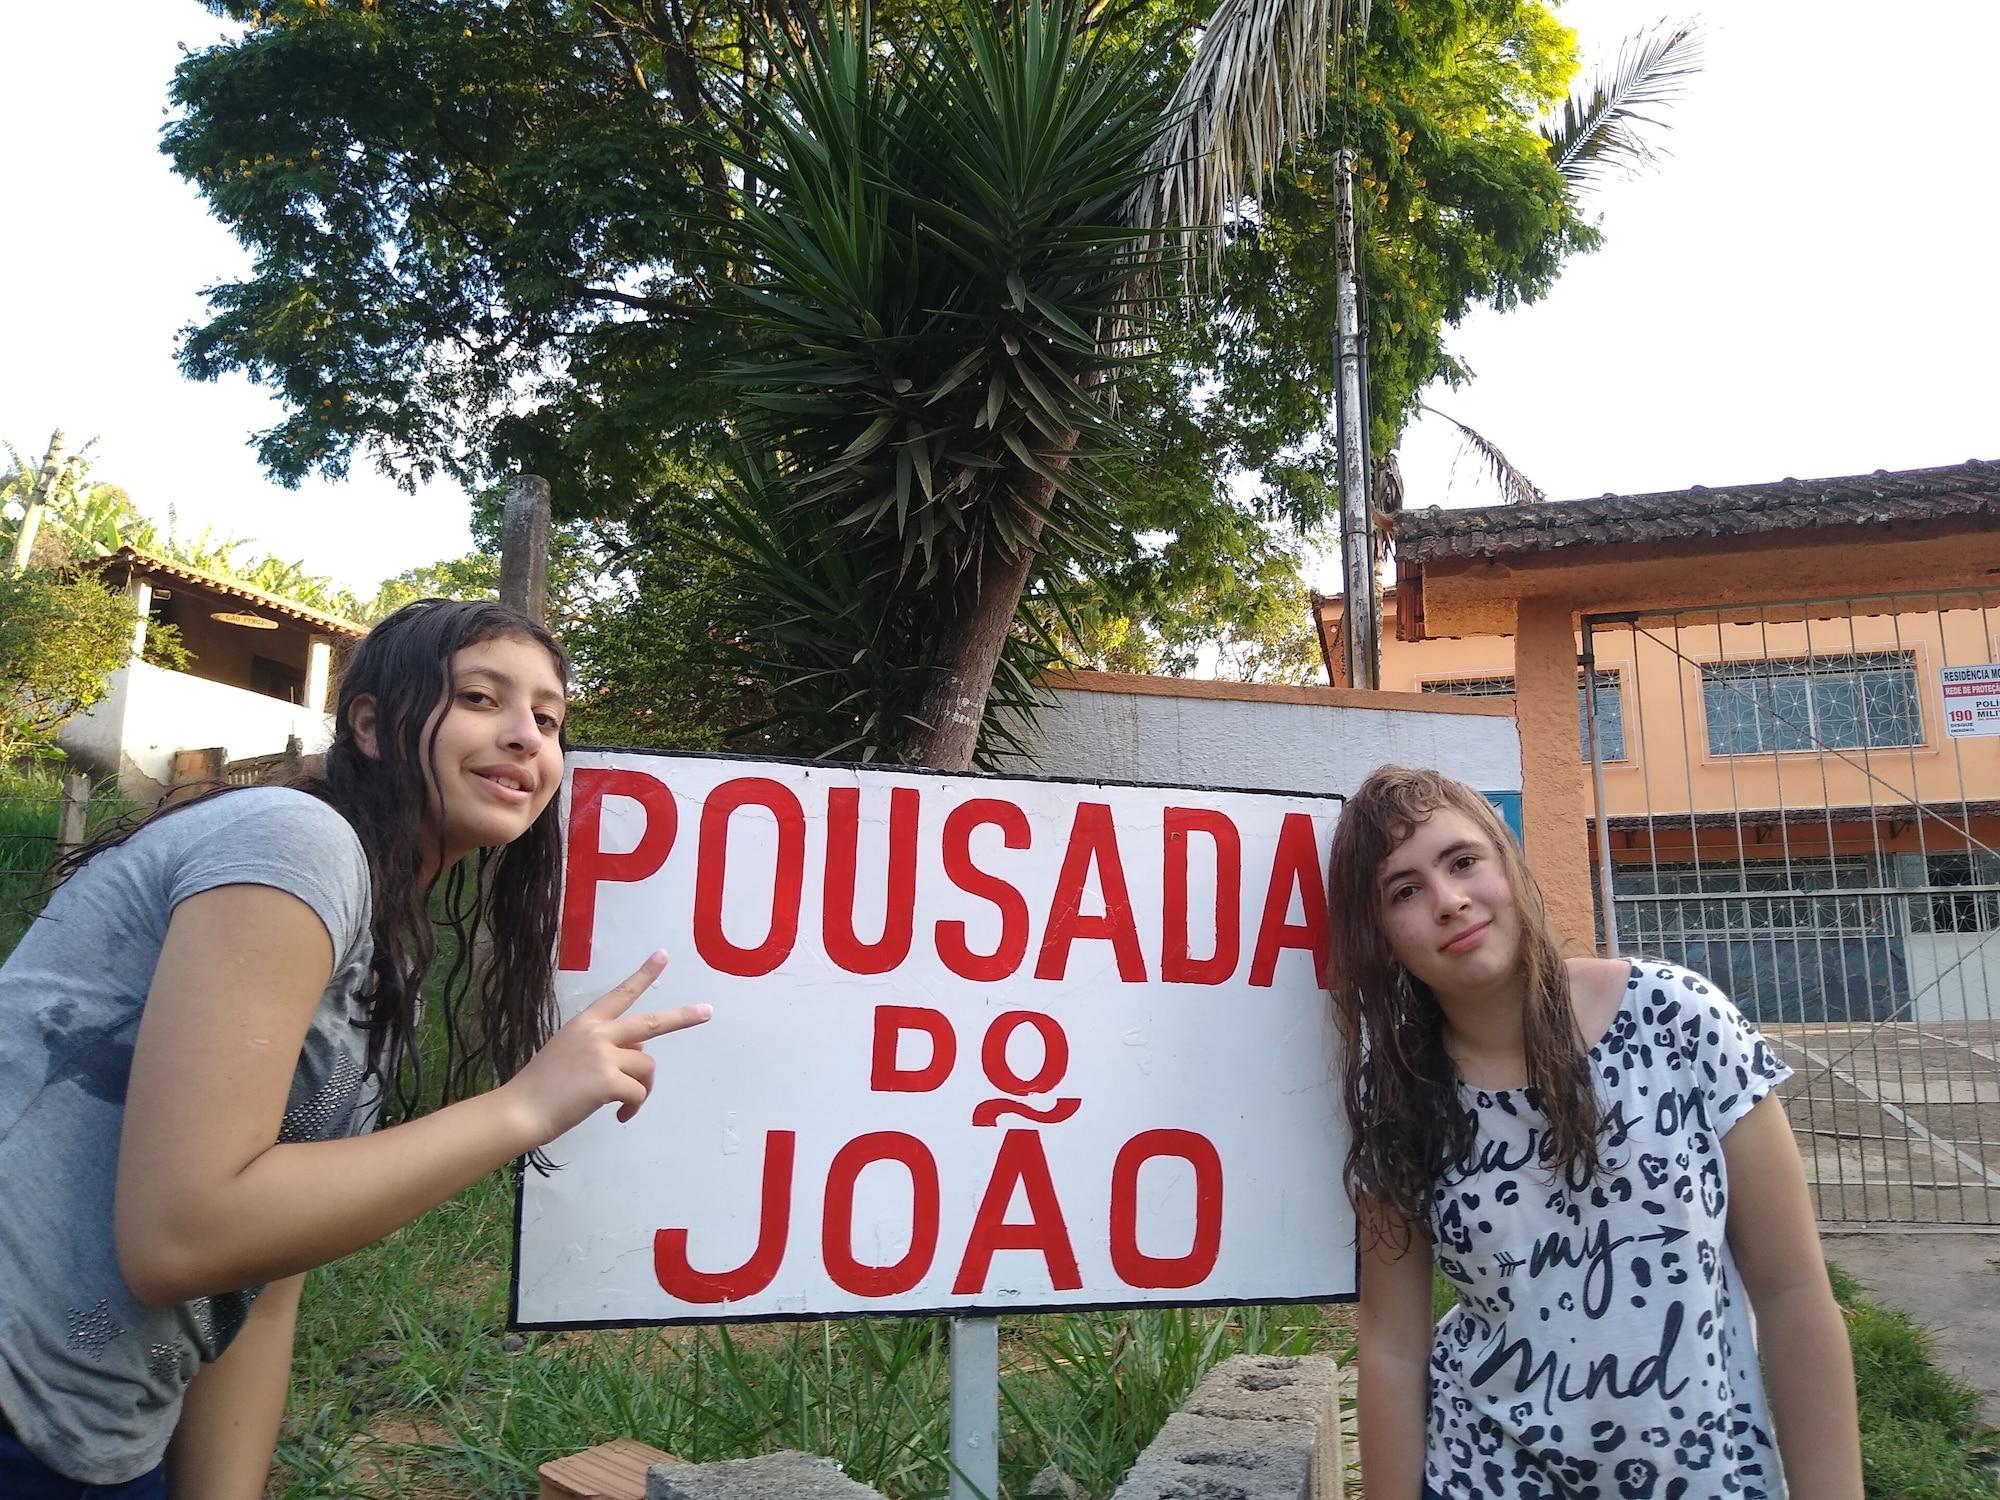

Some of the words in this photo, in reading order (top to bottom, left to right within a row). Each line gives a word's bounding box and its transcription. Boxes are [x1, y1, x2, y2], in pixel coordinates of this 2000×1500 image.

[1944, 669, 1990, 681] RESIDÊNCIA
[1945, 686, 1962, 695] REDE
[1962, 686, 1972, 694] DE
[1948, 709, 1973, 722] 190
[557, 767, 1330, 990] POUSADA
[870, 1004, 1070, 1095] DO
[1656, 1086, 1713, 1136] on
[653, 1097, 1224, 1303] JOÃO
[1529, 1218, 1635, 1319] my
